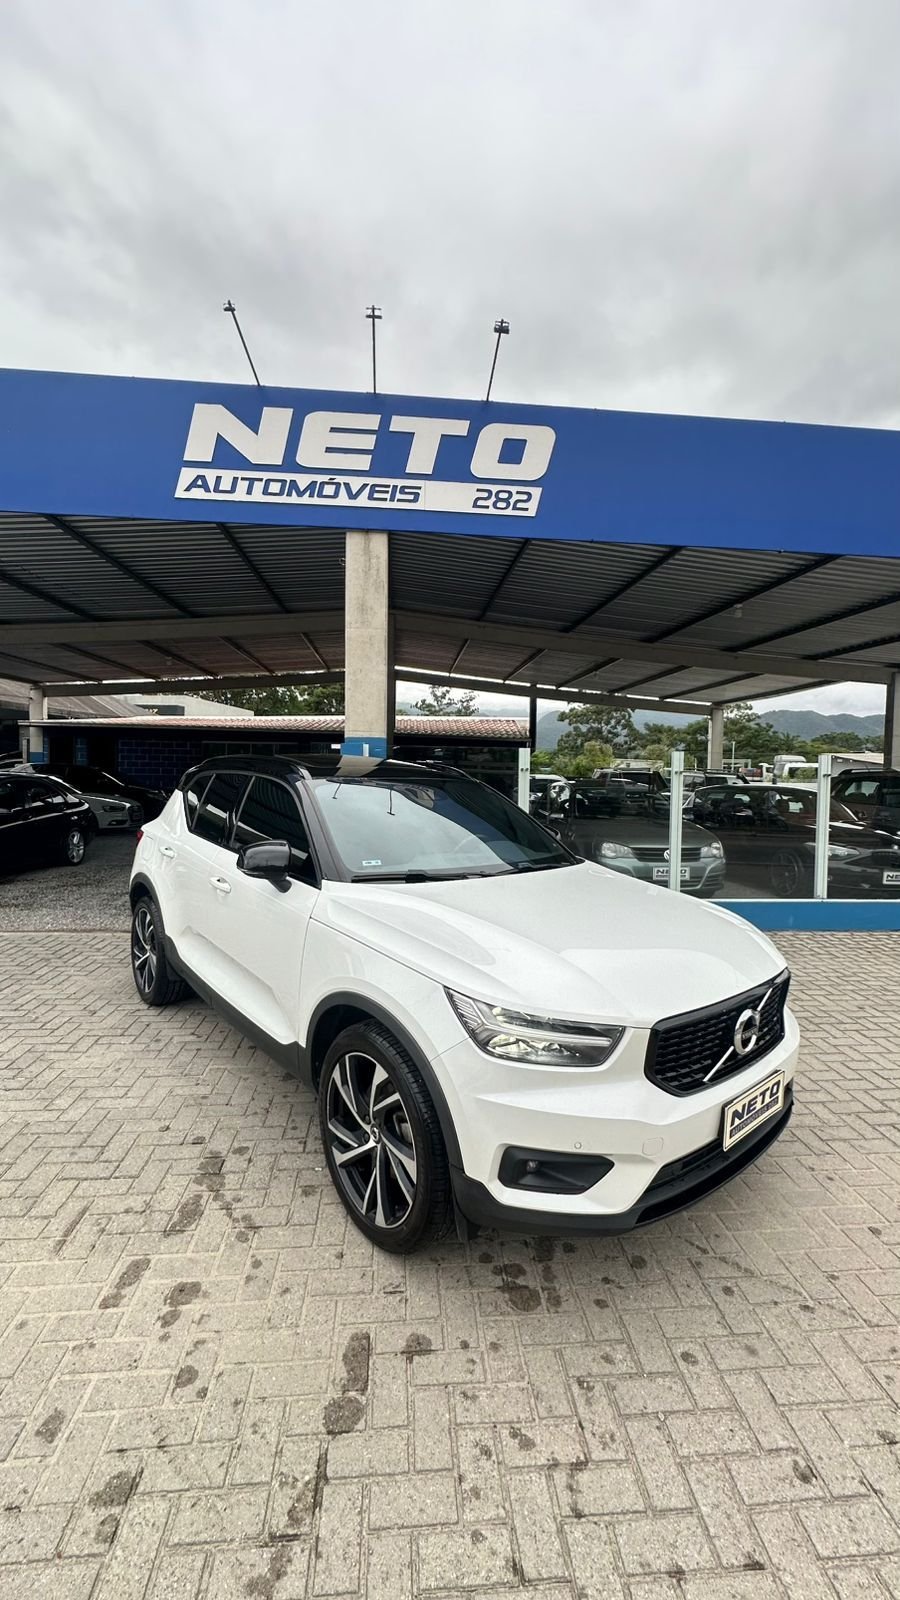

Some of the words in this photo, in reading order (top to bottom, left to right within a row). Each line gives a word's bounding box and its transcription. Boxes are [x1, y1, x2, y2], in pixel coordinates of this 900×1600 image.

[183, 403, 557, 481] NETO
[183, 474, 422, 504] AUTOMÓVEIS
[471, 488, 533, 512] 282
[730, 1080, 781, 1127] NETO
